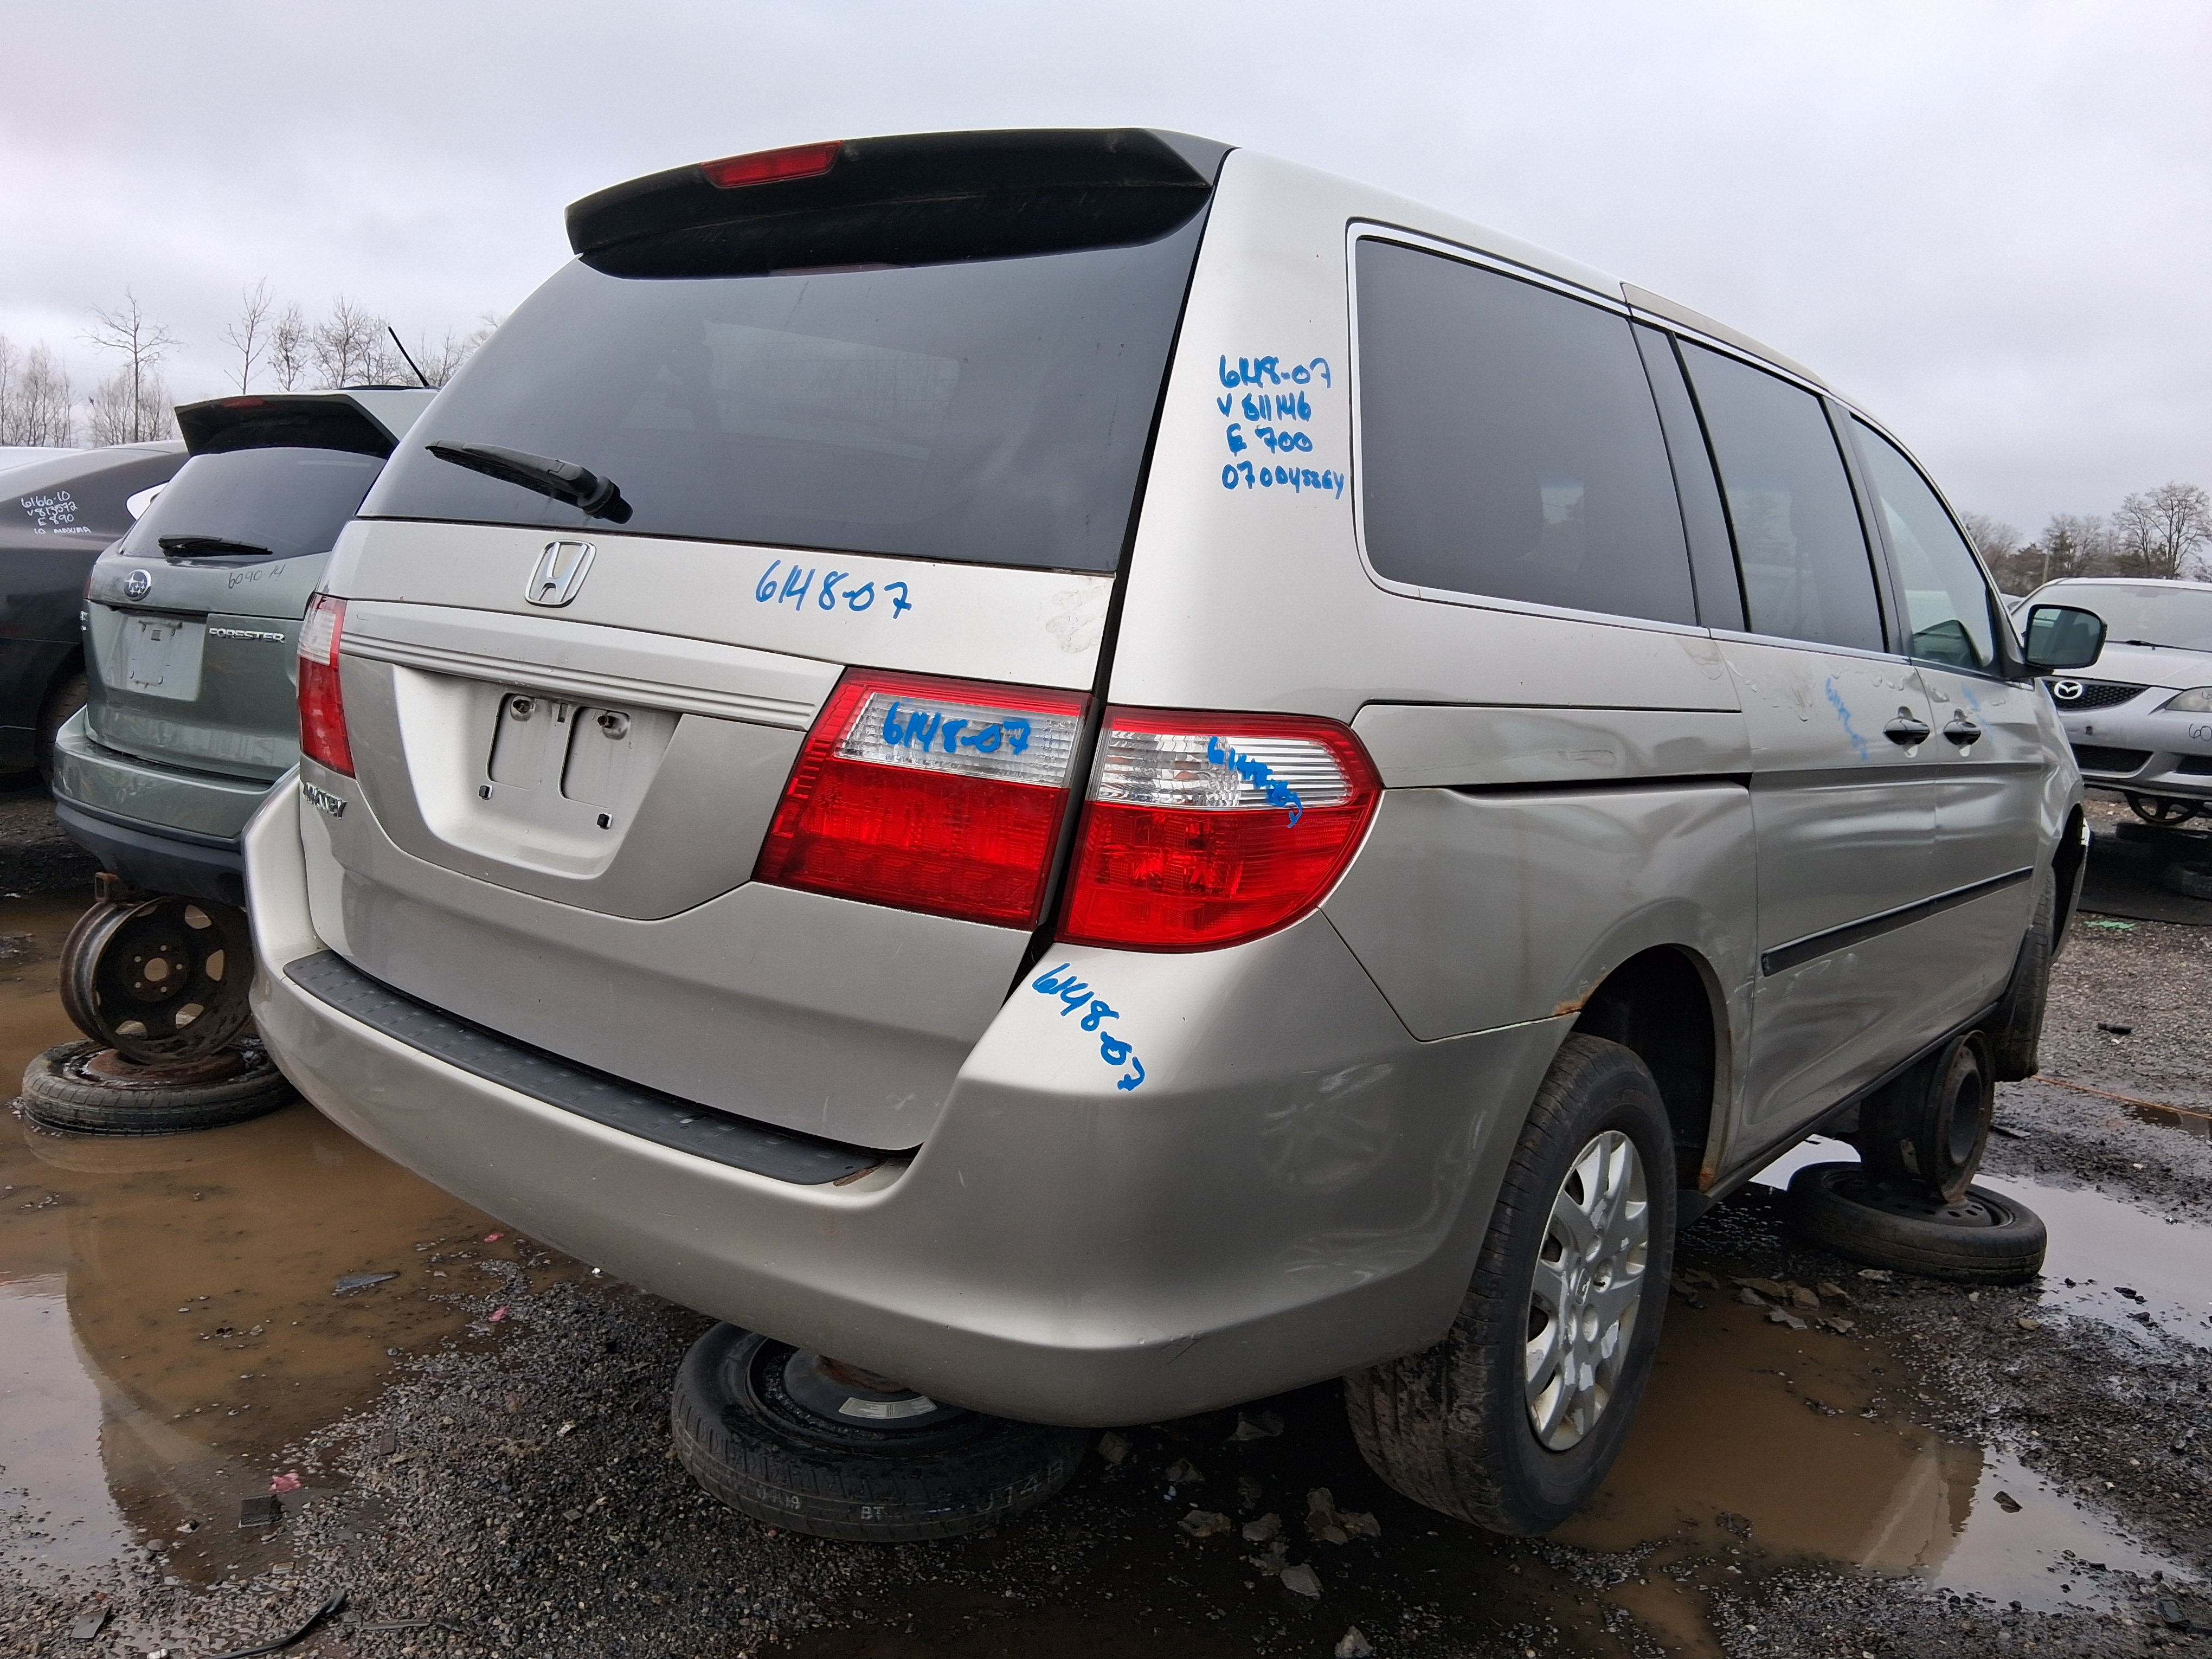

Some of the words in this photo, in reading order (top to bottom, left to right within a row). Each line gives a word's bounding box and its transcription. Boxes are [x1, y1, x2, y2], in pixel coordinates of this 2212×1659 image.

[1219, 354, 1332, 389] 6148-07
[1226, 423, 1247, 457] E
[1255, 425, 1313, 454] 700
[1221, 460, 1256, 490] 07
[37, 517, 47, 526] E
[49, 514, 74, 525] 890
[755, 560, 912, 619] 6148-07
[209, 627, 286, 644] FORESTER
[883, 702, 1031, 756] 6148-07
[1032, 963, 1145, 1091] 6148-07
